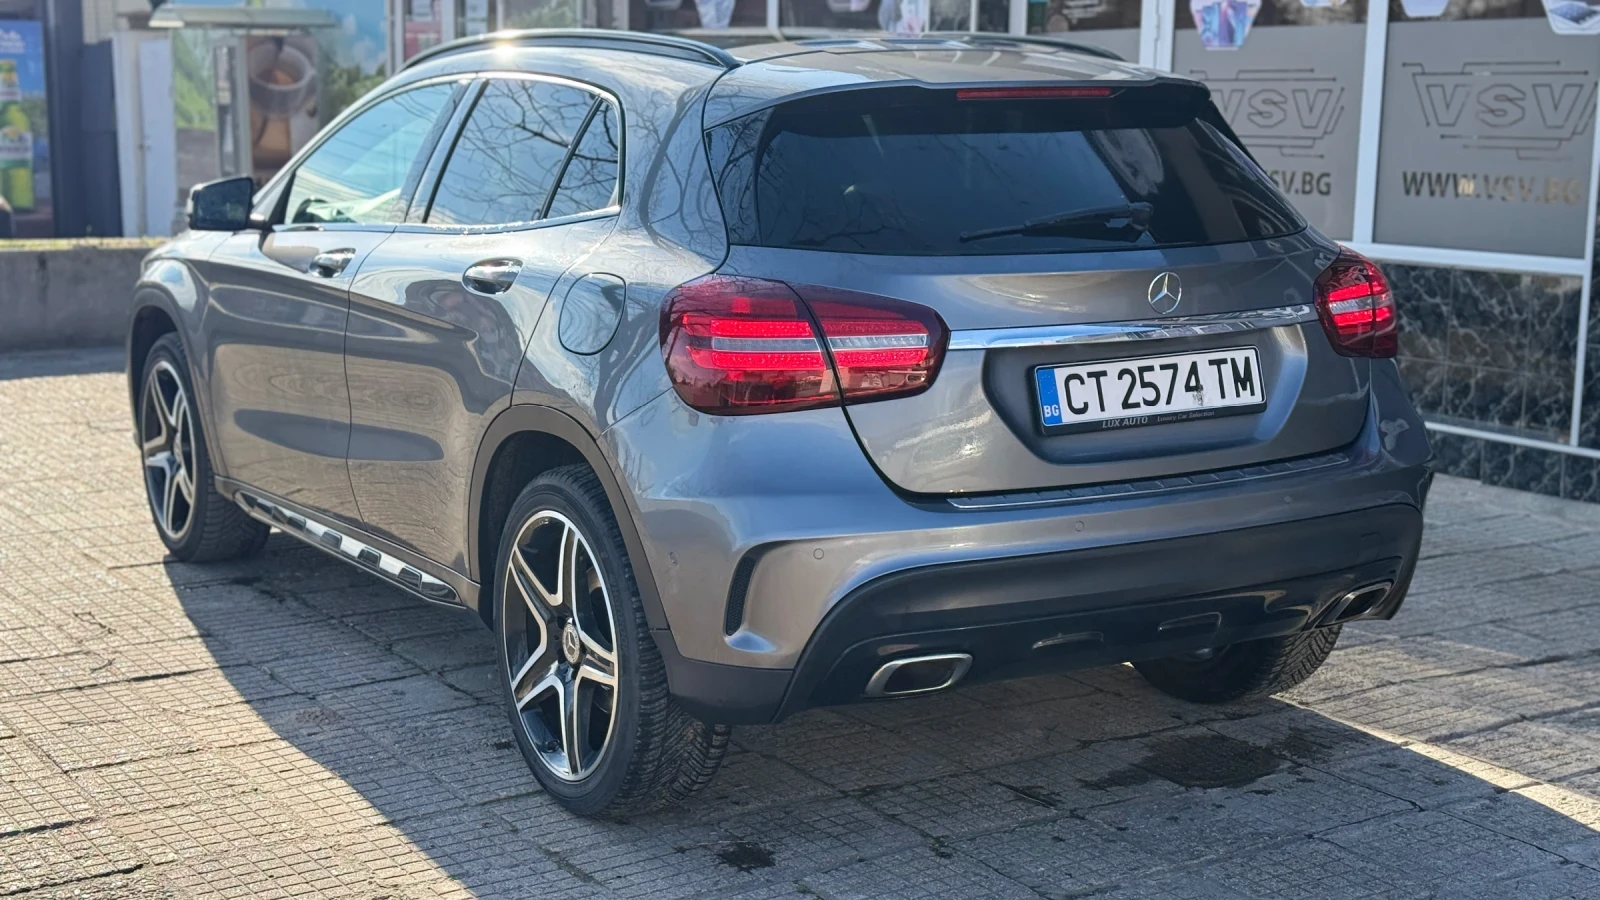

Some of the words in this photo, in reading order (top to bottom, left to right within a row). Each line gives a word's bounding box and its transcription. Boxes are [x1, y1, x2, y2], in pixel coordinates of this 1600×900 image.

[1425, 83, 1585, 130] VSV
[1402, 171, 1583, 204] WWW.VSV.BG
[1064, 370, 1108, 415] CT
[1117, 361, 1204, 410] 2574
[1208, 356, 1256, 400] TM
[1043, 404, 1060, 418] BG
[1102, 418, 1120, 429] LUX
[1122, 416, 1149, 427] AUTO
[1188, 411, 1215, 419] Selection
